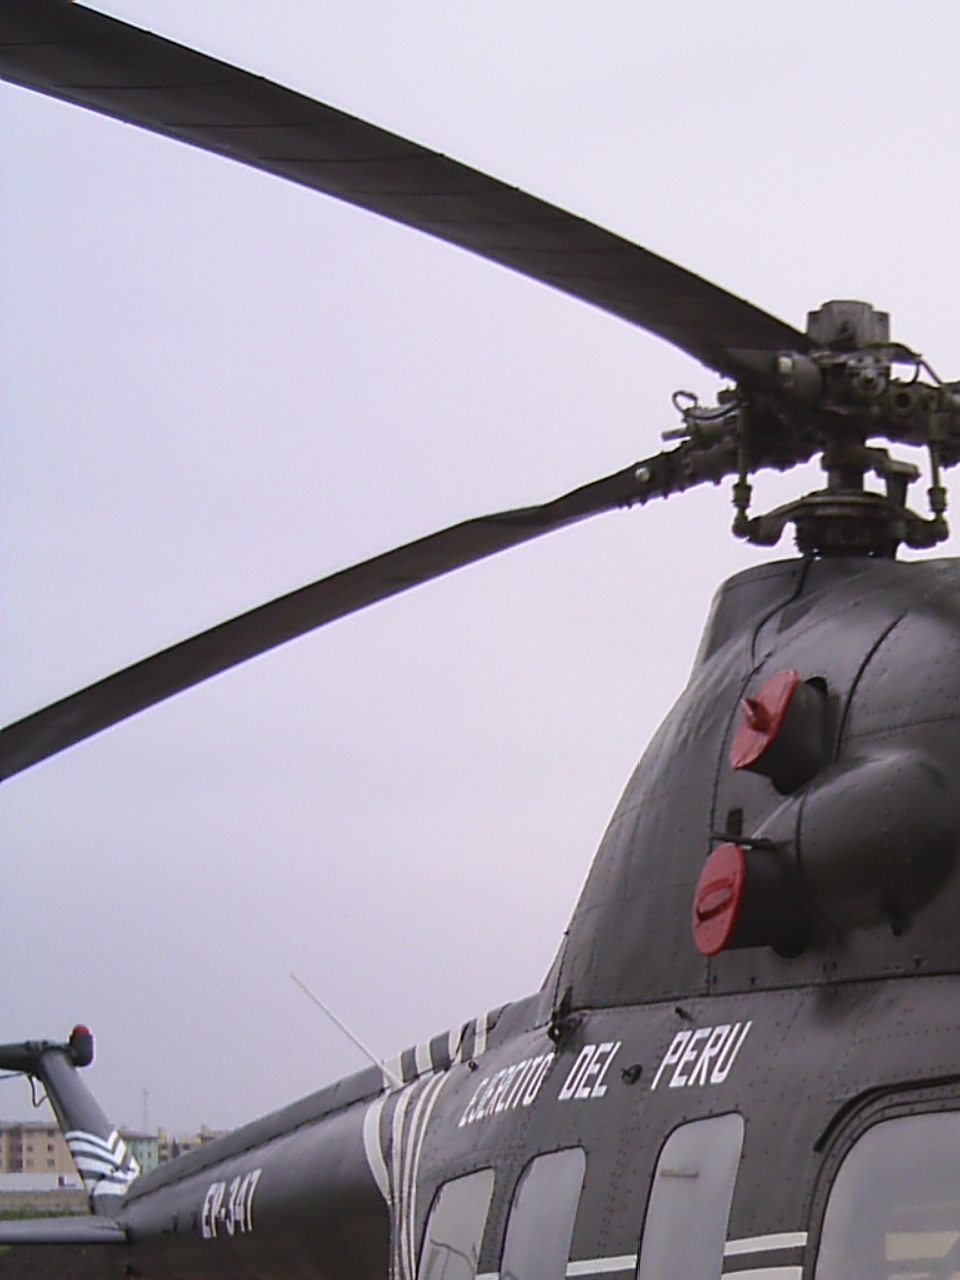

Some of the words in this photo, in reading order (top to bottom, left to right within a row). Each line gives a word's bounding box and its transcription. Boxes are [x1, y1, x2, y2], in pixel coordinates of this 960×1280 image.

[558, 1042, 621, 1100] DEL
[651, 1021, 752, 1090] PERU
[202, 1168, 262, 1238] EP-347
